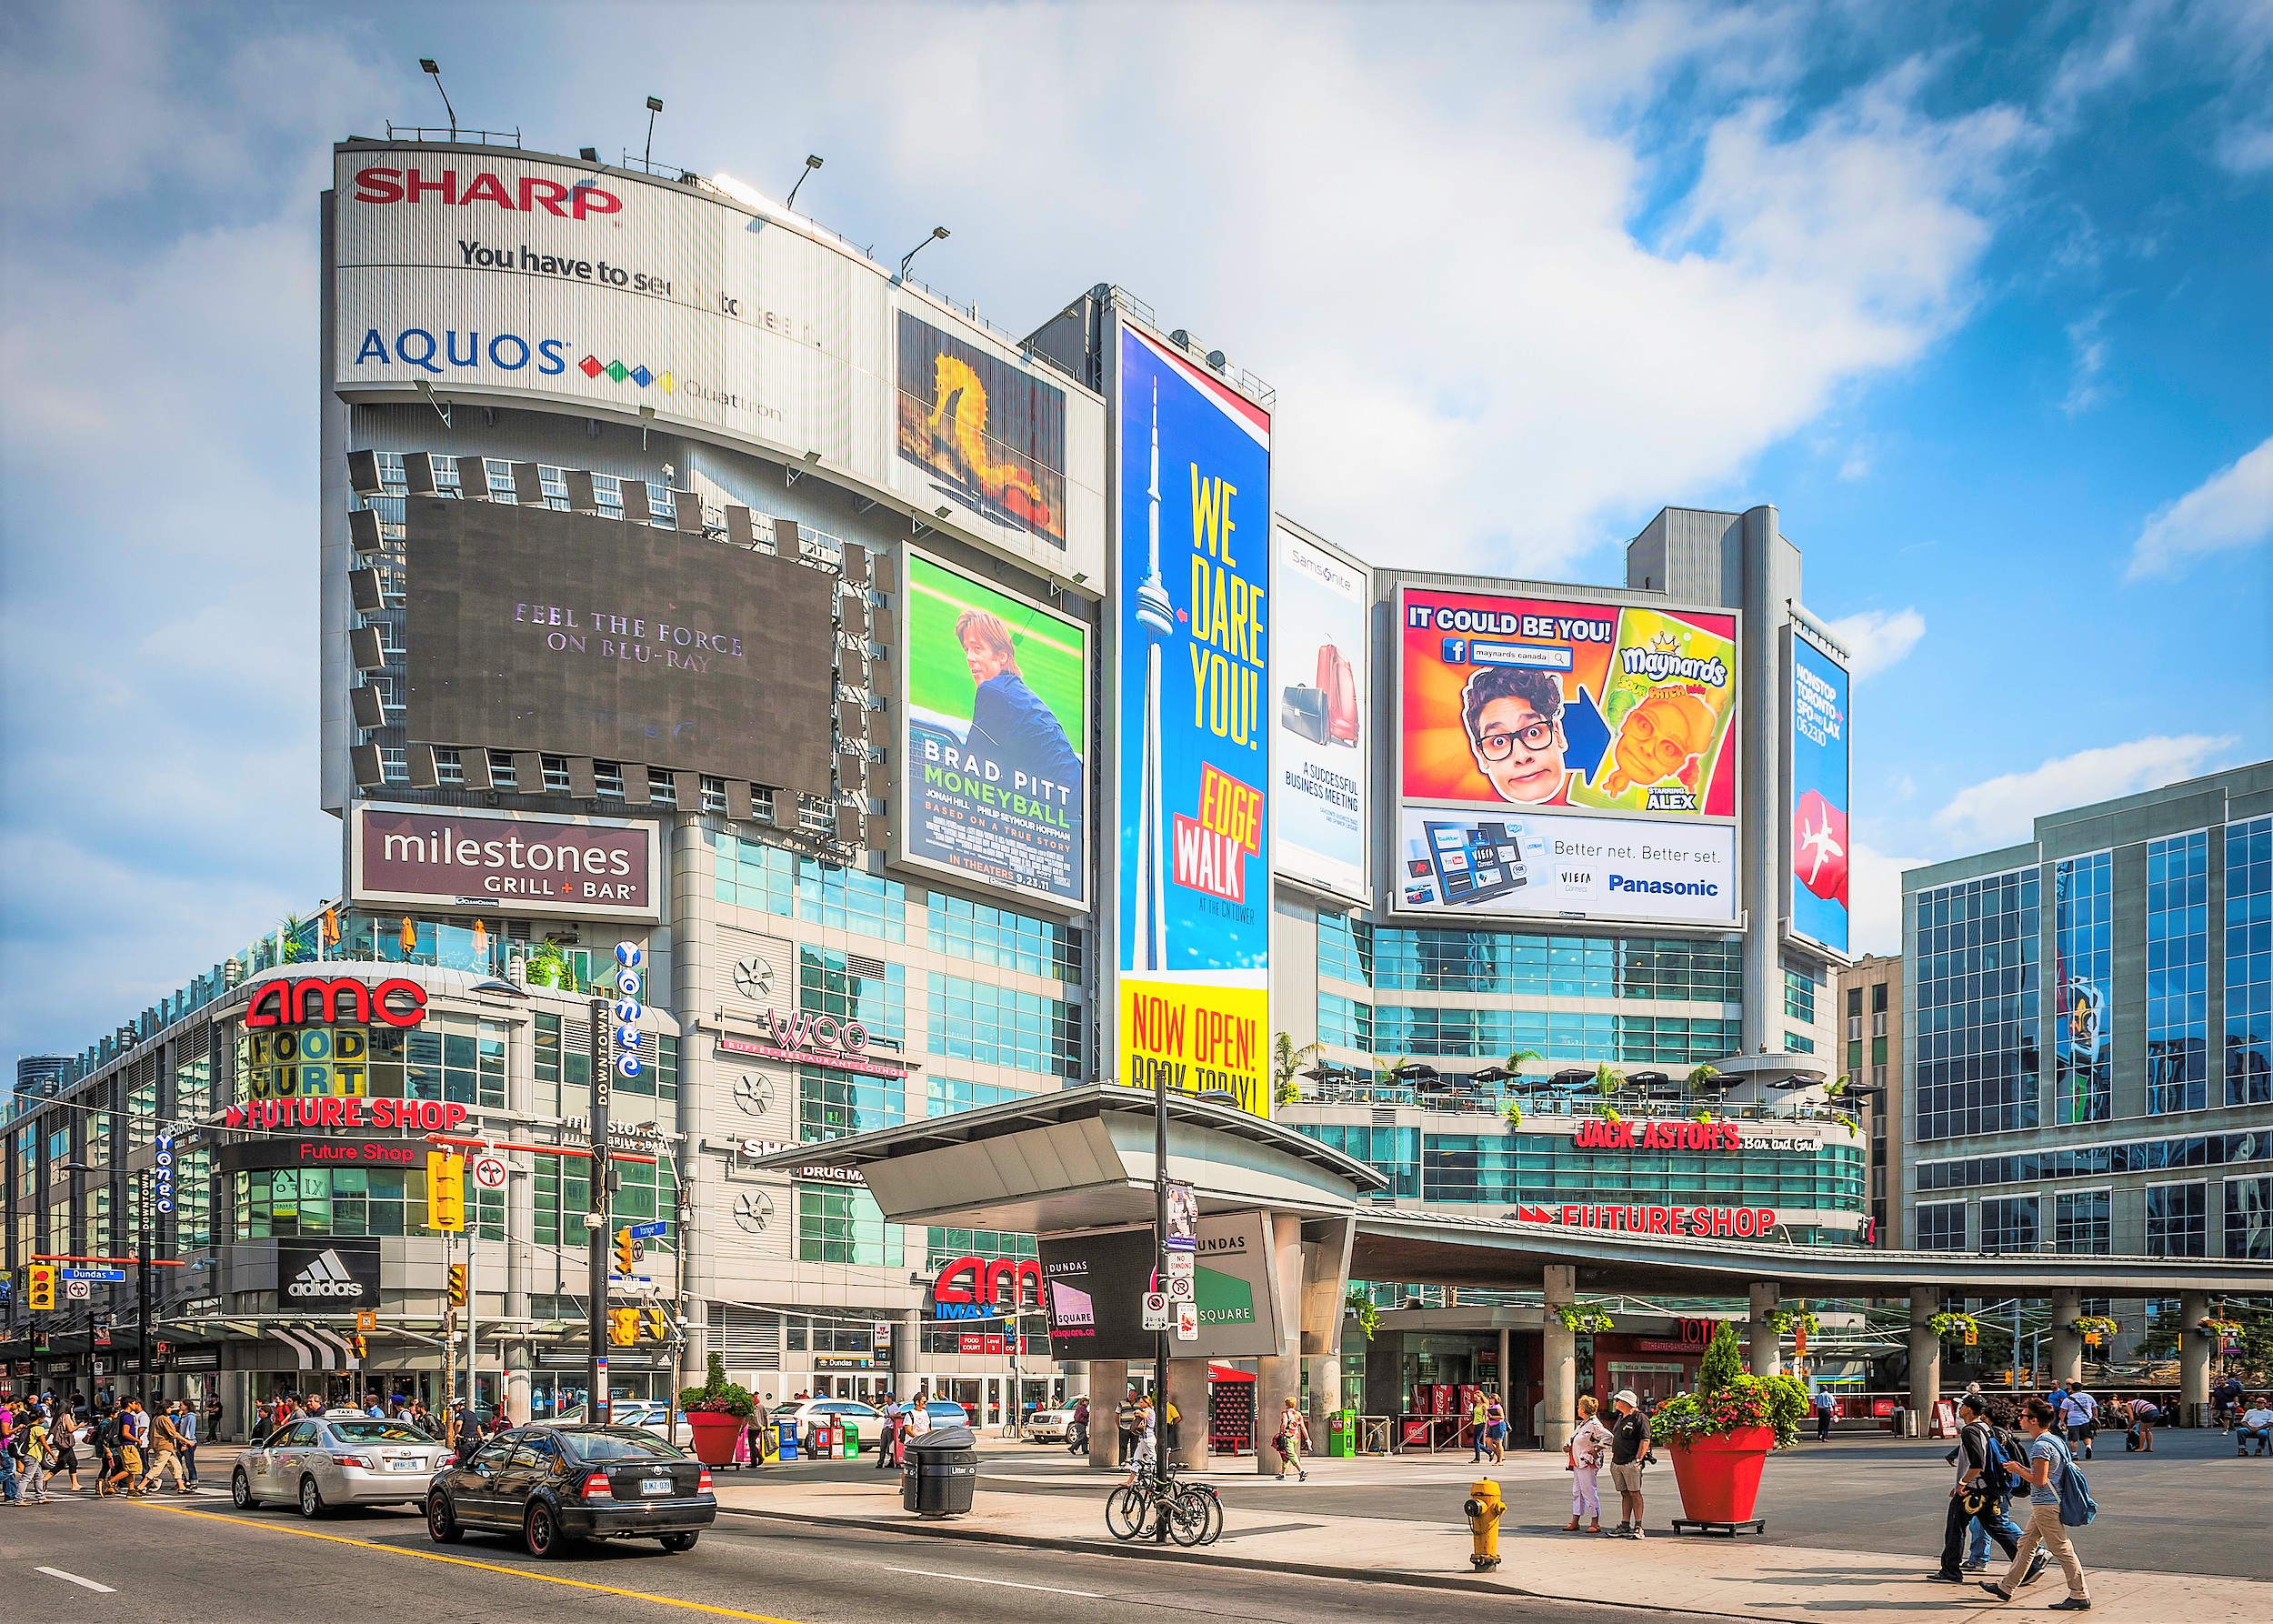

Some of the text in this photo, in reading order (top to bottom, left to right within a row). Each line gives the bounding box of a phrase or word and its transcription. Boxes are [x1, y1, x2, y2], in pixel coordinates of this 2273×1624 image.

[354, 167, 623, 221] SHARP
[458, 240, 514, 267] You
[521, 246, 592, 279] have
[597, 261, 628, 286] to
[634, 273, 673, 296] se
[355, 328, 566, 375] AQUOS
[1190, 462, 1237, 568] WE
[1293, 550, 1351, 591] Samsonite
[1191, 553, 1265, 669] DARE
[1409, 606, 1611, 642] IT COULD BE YOU!
[515, 603, 743, 657] FEEL THE FORCE
[547, 633, 712, 673] ON BLU-RAY
[1476, 649, 1547, 660] maynards canada
[1189, 641, 1258, 751] YOU!
[1648, 685, 1686, 699] PATCH
[1797, 663, 1837, 702] NONSTOP
[1797, 680, 1837, 719] TORONTO
[1797, 698, 1814, 721] SFO
[1823, 717, 1840, 740] LAX
[925, 739, 1071, 806] BRAD PITT
[1303, 762, 1358, 796] A SUCCESSFUL
[925, 764, 1071, 829] MONEYBALL
[1202, 768, 1260, 850] EDGE
[1286, 771, 1358, 812] BUSINESS MEETING
[1647, 794, 1697, 810] ALEX
[925, 801, 1071, 853] BASED ON A TRUE STORY
[926, 788, 1071, 842] JONAH HILL PHILIP SEYMOUR HOFFMAN
[384, 827, 630, 876] milestones
[1177, 819, 1239, 898] WALK
[1555, 841, 1720, 863] Better net. Better set.
[484, 876, 631, 899] GRILL BAR
[949, 854, 960, 865] IN
[964, 857, 1014, 880] THEATERS
[1016, 873, 1049, 890] 9.23.11
[1565, 884, 1588, 893] Connect
[1609, 874, 1718, 897] Panasonic
[1199, 897, 1255, 926] AT THE CN TOWER
[768, 1007, 869, 1050] WOO
[1133, 992, 1256, 1072] NOW OPEN!
[597, 1008, 608, 1106] DOWNTOWN
[728, 1042, 905, 1078] BUFFET RESTAURANT LOUNGE
[247, 1098, 466, 1130] FUTURE SHOP
[566, 1114, 665, 1138] mistoes
[300, 1143, 415, 1164] Future Shop
[1576, 1120, 1824, 1152] JACK ASTOR'S Bar and Grill
[804, 1166, 866, 1183] DRUG MA
[639, 1226, 655, 1237] Yonge
[1562, 1204, 1777, 1238] FUTURE SHOP
[1194, 1236, 1246, 1252] UNDAS
[74, 1270, 106, 1278] Dundas
[1049, 1261, 1087, 1272] DUNDAS
[288, 1279, 363, 1297] adidas
[936, 1303, 996, 1319] IMAX
[1058, 1314, 1091, 1324] SQUARE
[1199, 1307, 1251, 1322] SQUARE
[951, 1466, 966, 1474] Litter
